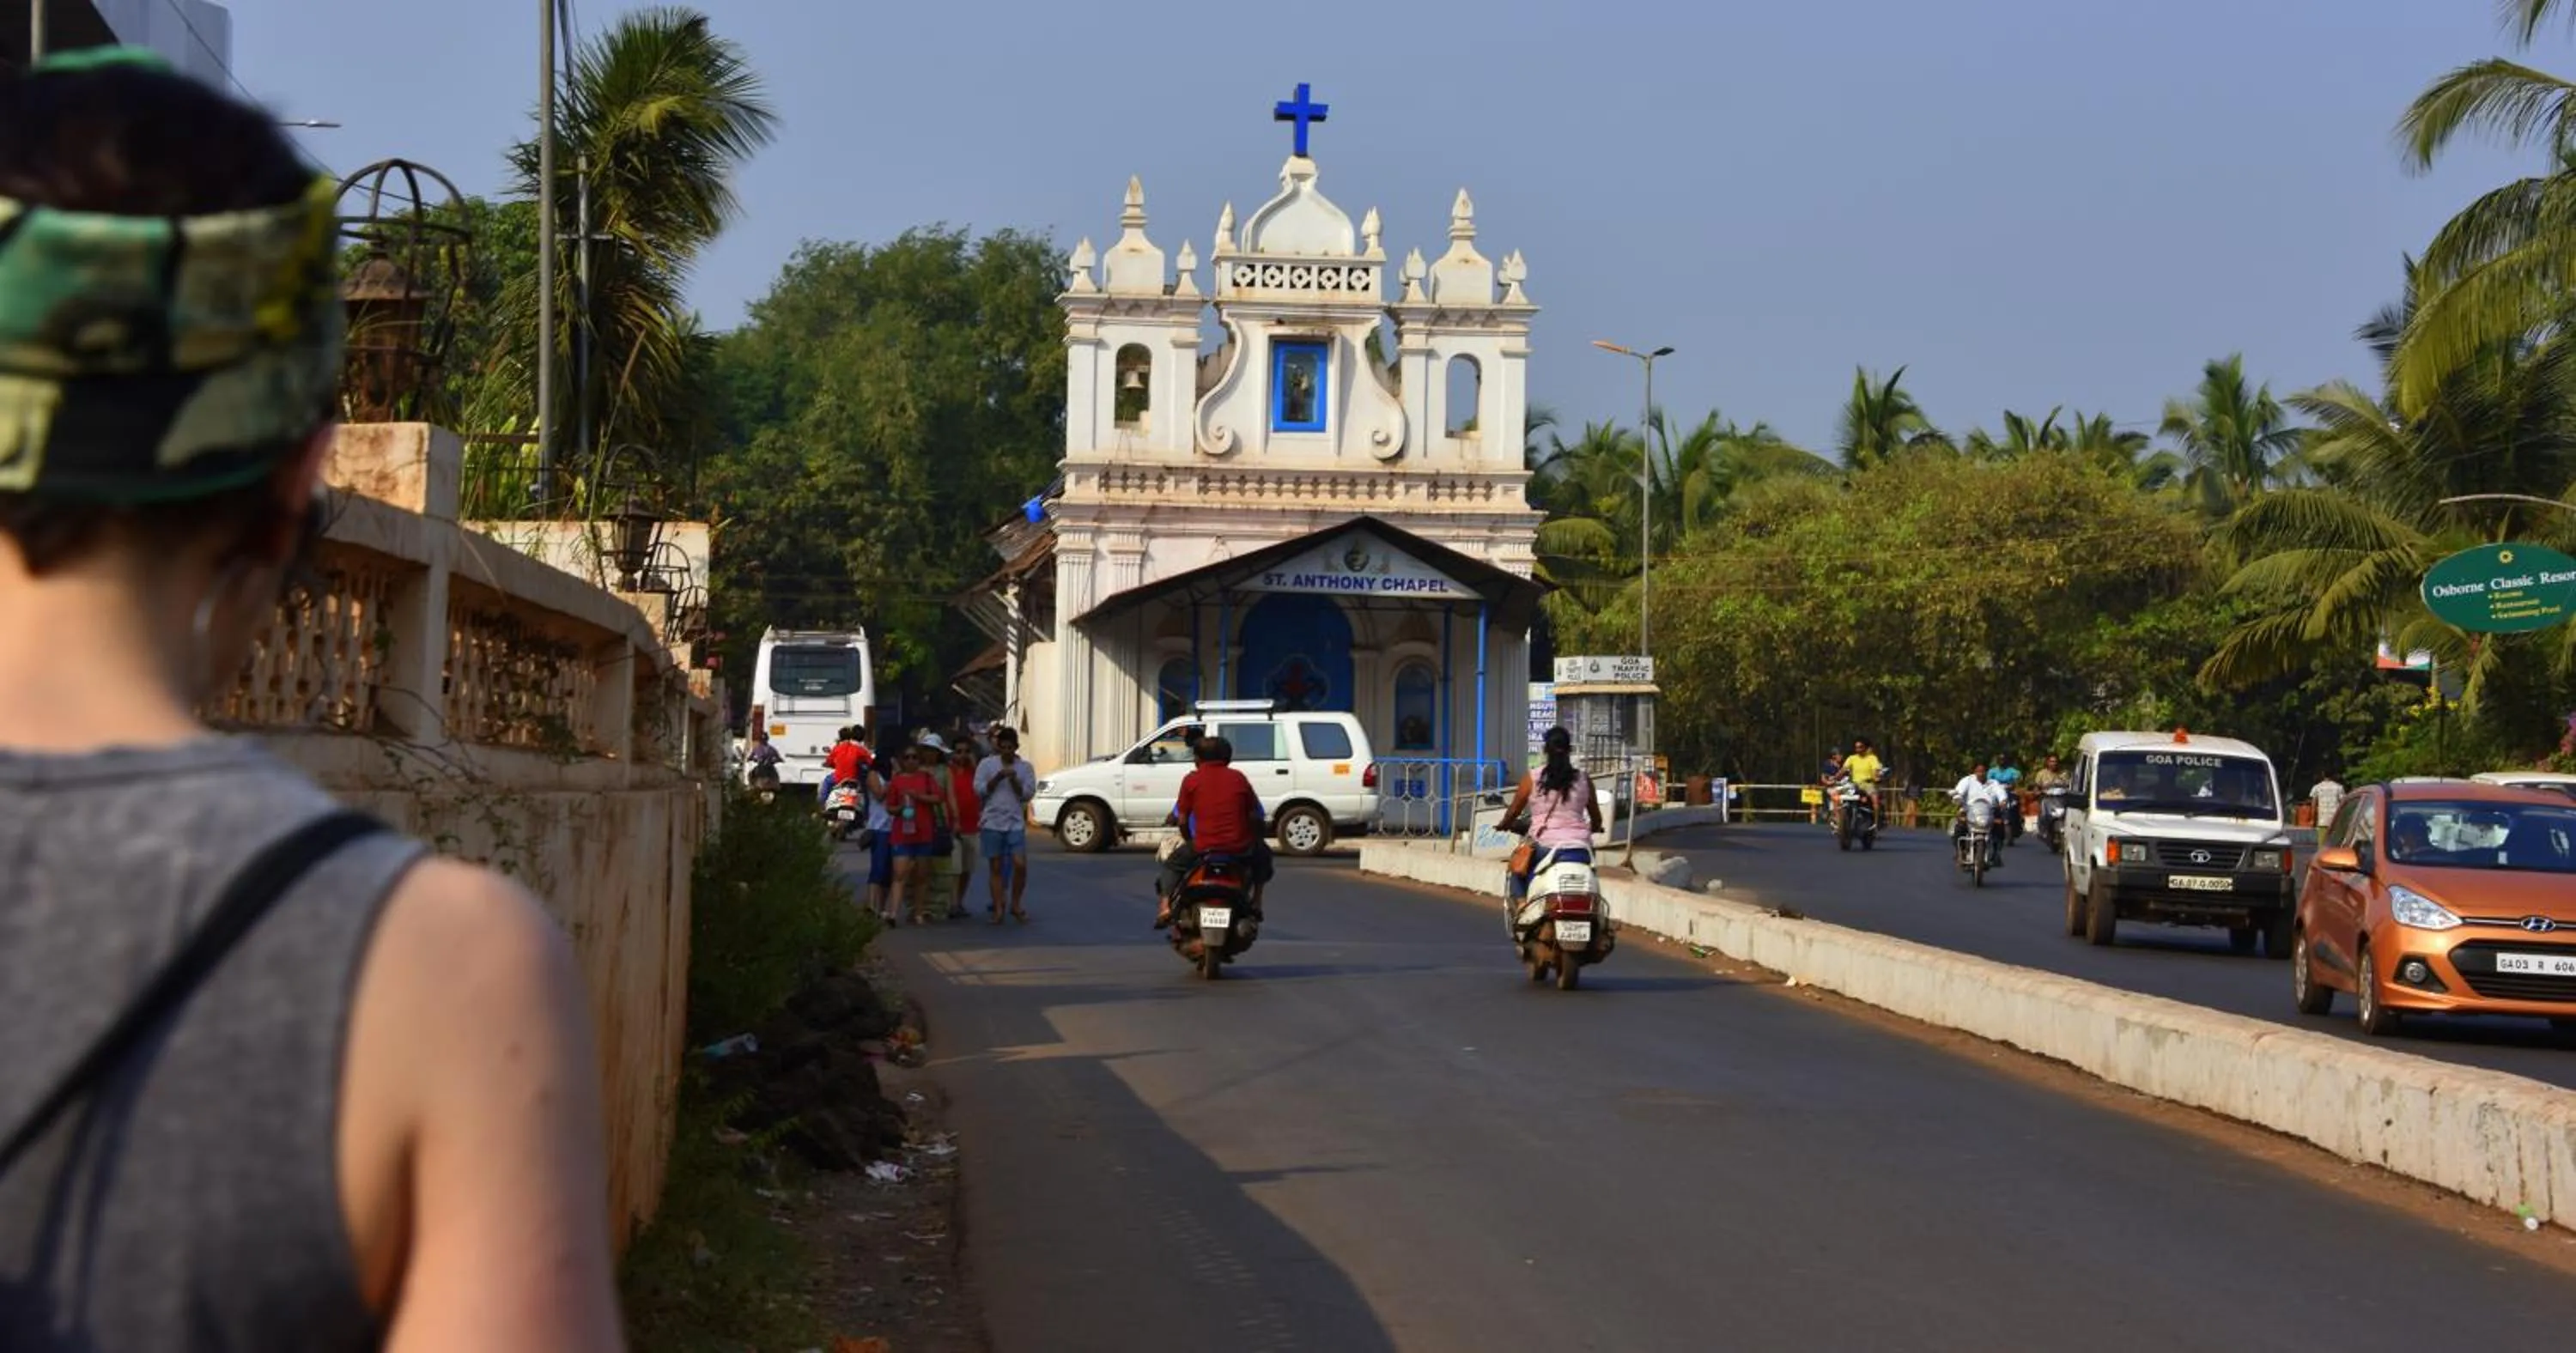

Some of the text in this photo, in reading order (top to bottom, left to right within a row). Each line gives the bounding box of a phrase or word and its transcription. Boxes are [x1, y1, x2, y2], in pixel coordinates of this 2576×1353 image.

[1263, 573, 1449, 592] ST. ANTHONY CHAPEL
[2433, 584, 2484, 598] Osborne
[2490, 576, 2535, 590] Classic
[2146, 755, 2222, 768] GOA POLICE
